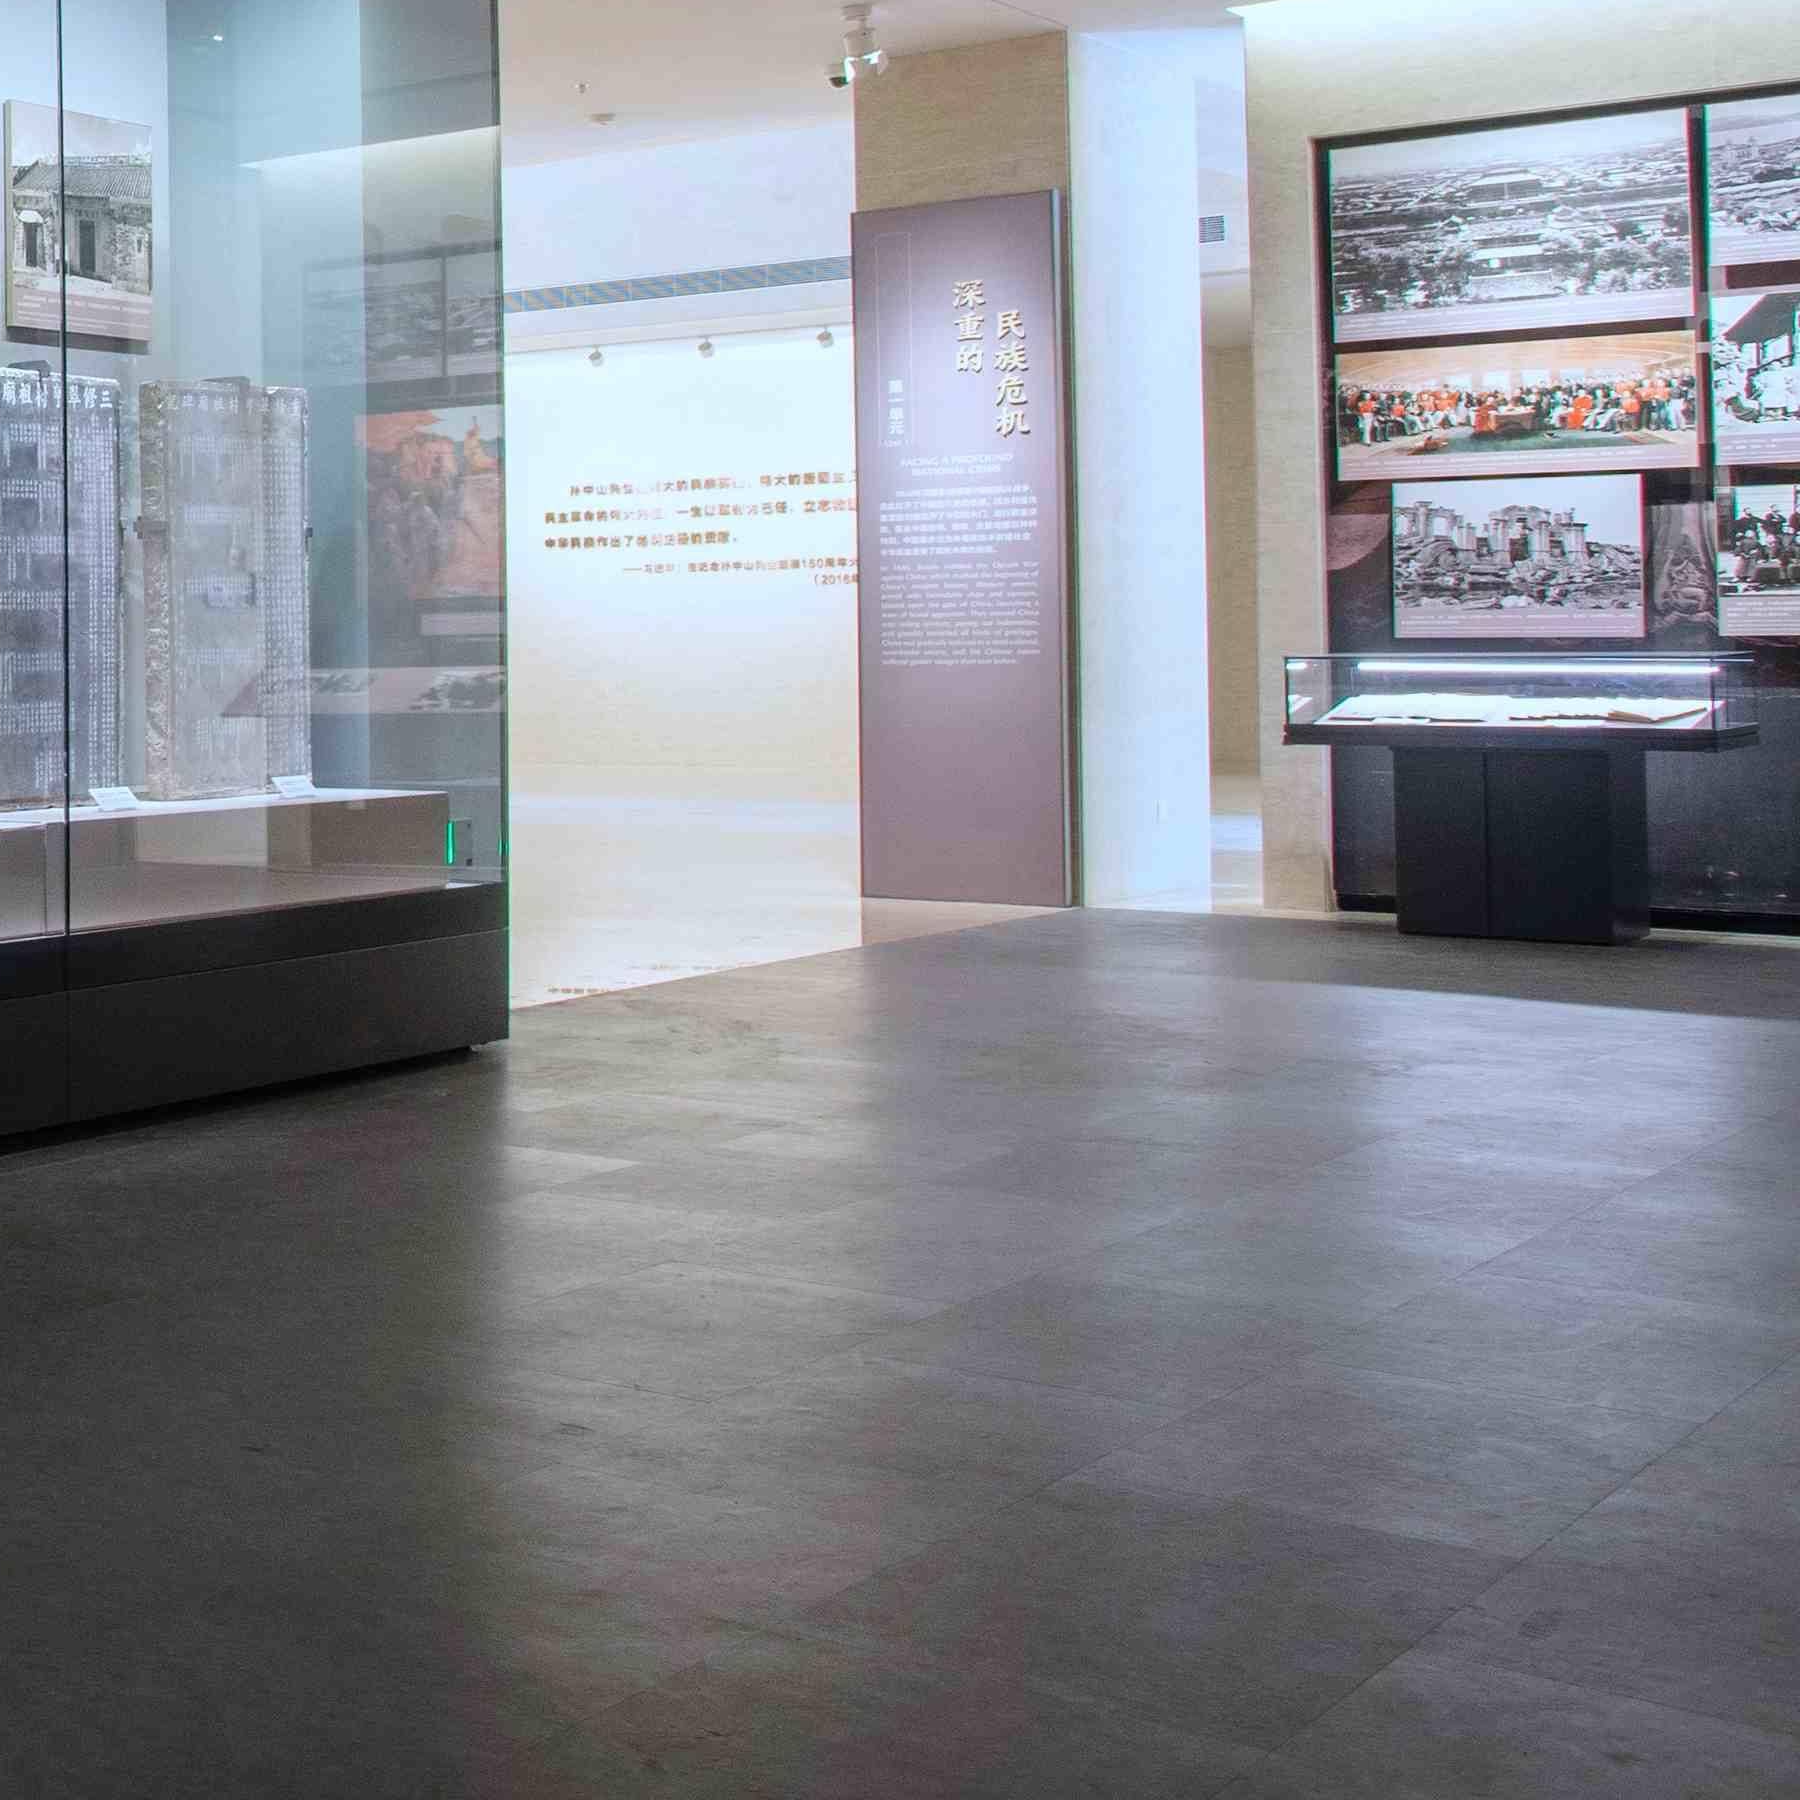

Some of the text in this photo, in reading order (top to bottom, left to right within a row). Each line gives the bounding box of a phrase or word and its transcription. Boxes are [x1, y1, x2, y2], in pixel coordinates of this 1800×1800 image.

[951, 279, 987, 374] 深重的
[994, 309, 1031, 439] 民族危机
[887, 378, 905, 435] 第一单元
